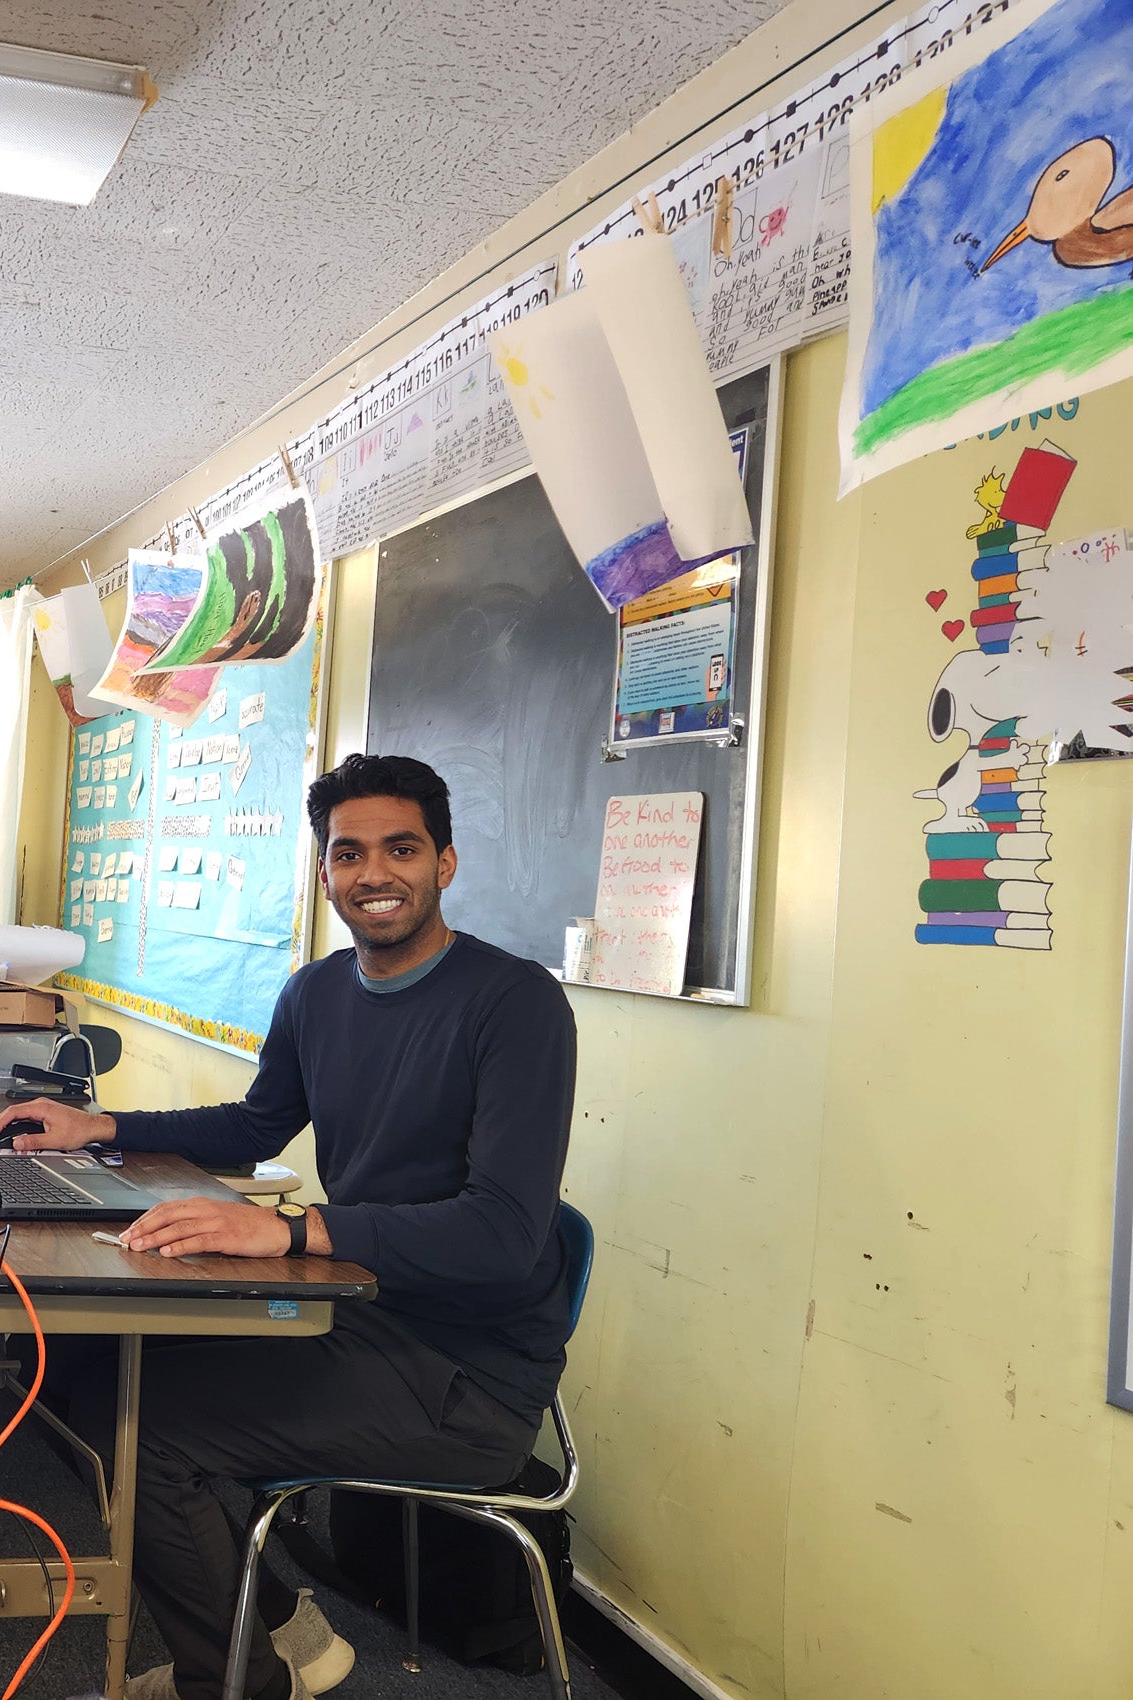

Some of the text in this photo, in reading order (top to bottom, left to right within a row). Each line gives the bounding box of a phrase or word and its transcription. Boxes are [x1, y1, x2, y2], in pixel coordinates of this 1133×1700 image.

[731, 149, 764, 192] 126
[770, 121, 809, 169] 127
[319, 434, 334, 455] 109
[335, 425, 348, 444] 110
[350, 410, 363, 434] 111
[365, 400, 379, 424] 112
[380, 388, 396, 413] 113
[397, 376, 414, 402] 114
[416, 361, 433, 389] 115
[433, 349, 454, 378] 116
[454, 334, 477, 362] 117
[606, 800, 700, 829] Be Kind to
[604, 830, 695, 851] one another
[604, 855, 618, 878] Be
[670, 860, 690, 874] to
